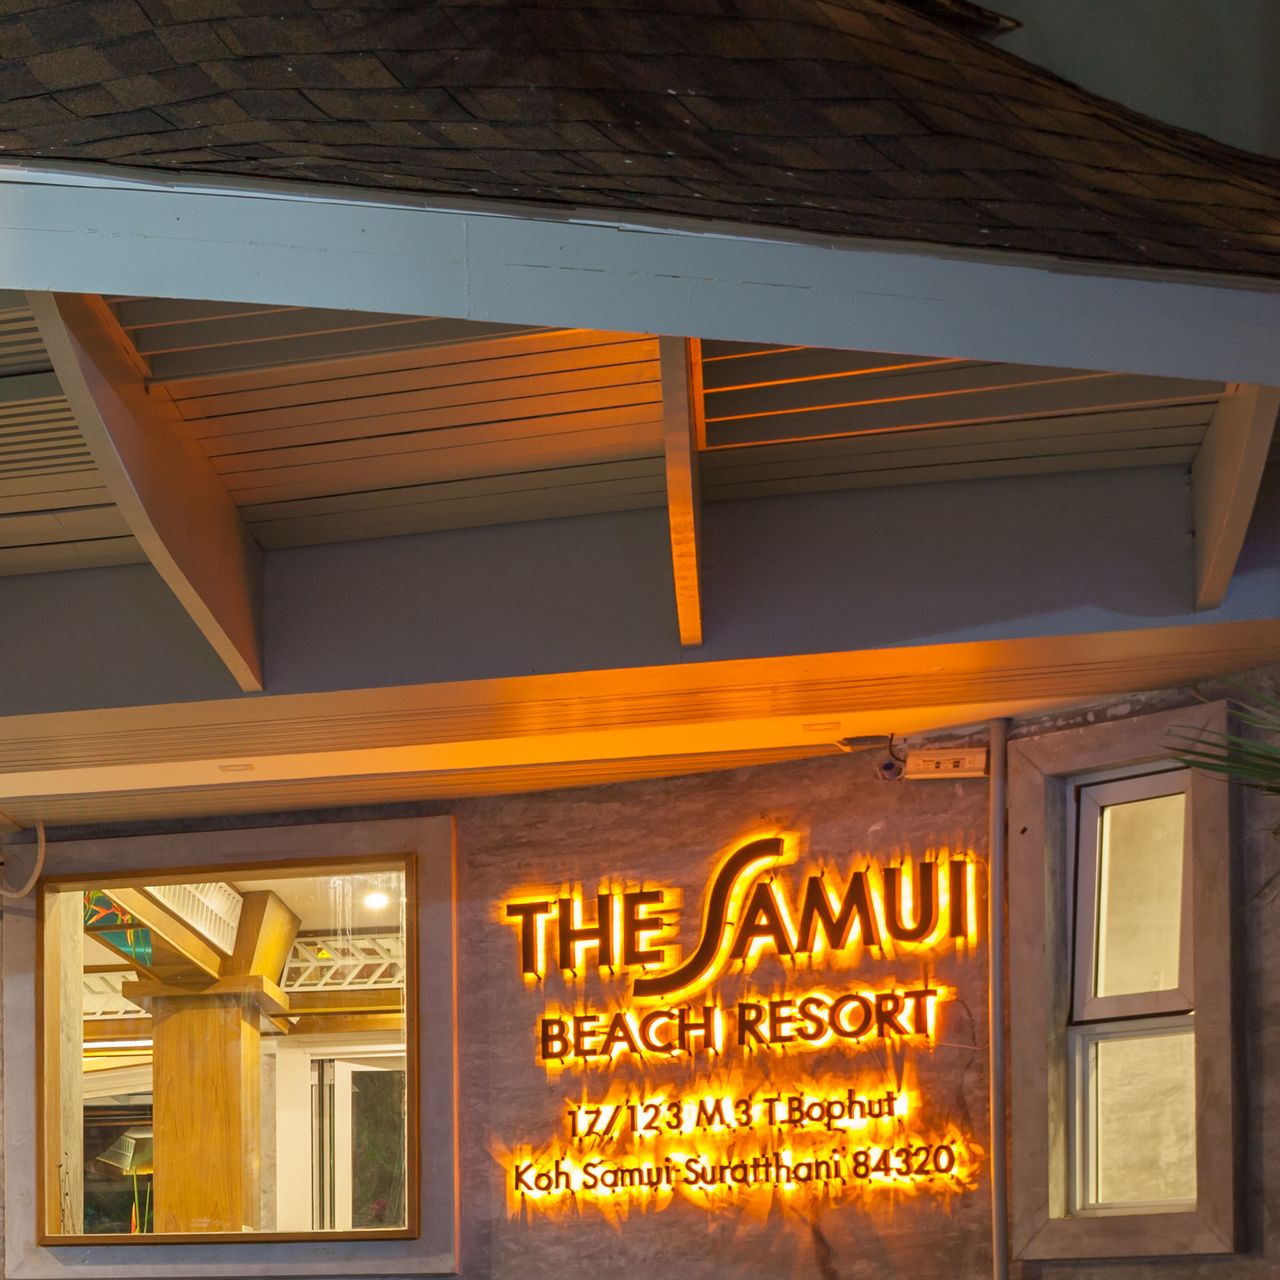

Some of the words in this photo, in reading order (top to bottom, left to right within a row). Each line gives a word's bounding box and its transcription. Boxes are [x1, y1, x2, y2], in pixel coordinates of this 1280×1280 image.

[506, 890, 664, 974] THE
[633, 837, 968, 997] SAMUI
[541, 1006, 715, 1061] BEACH
[738, 989, 937, 1047] RESORT
[567, 1102, 684, 1137] 17/123
[514, 1159, 572, 1191] Koh
[582, 1156, 673, 1190] Samui
[683, 1149, 841, 1186] Suratthani
[851, 1145, 955, 1179] 84320
